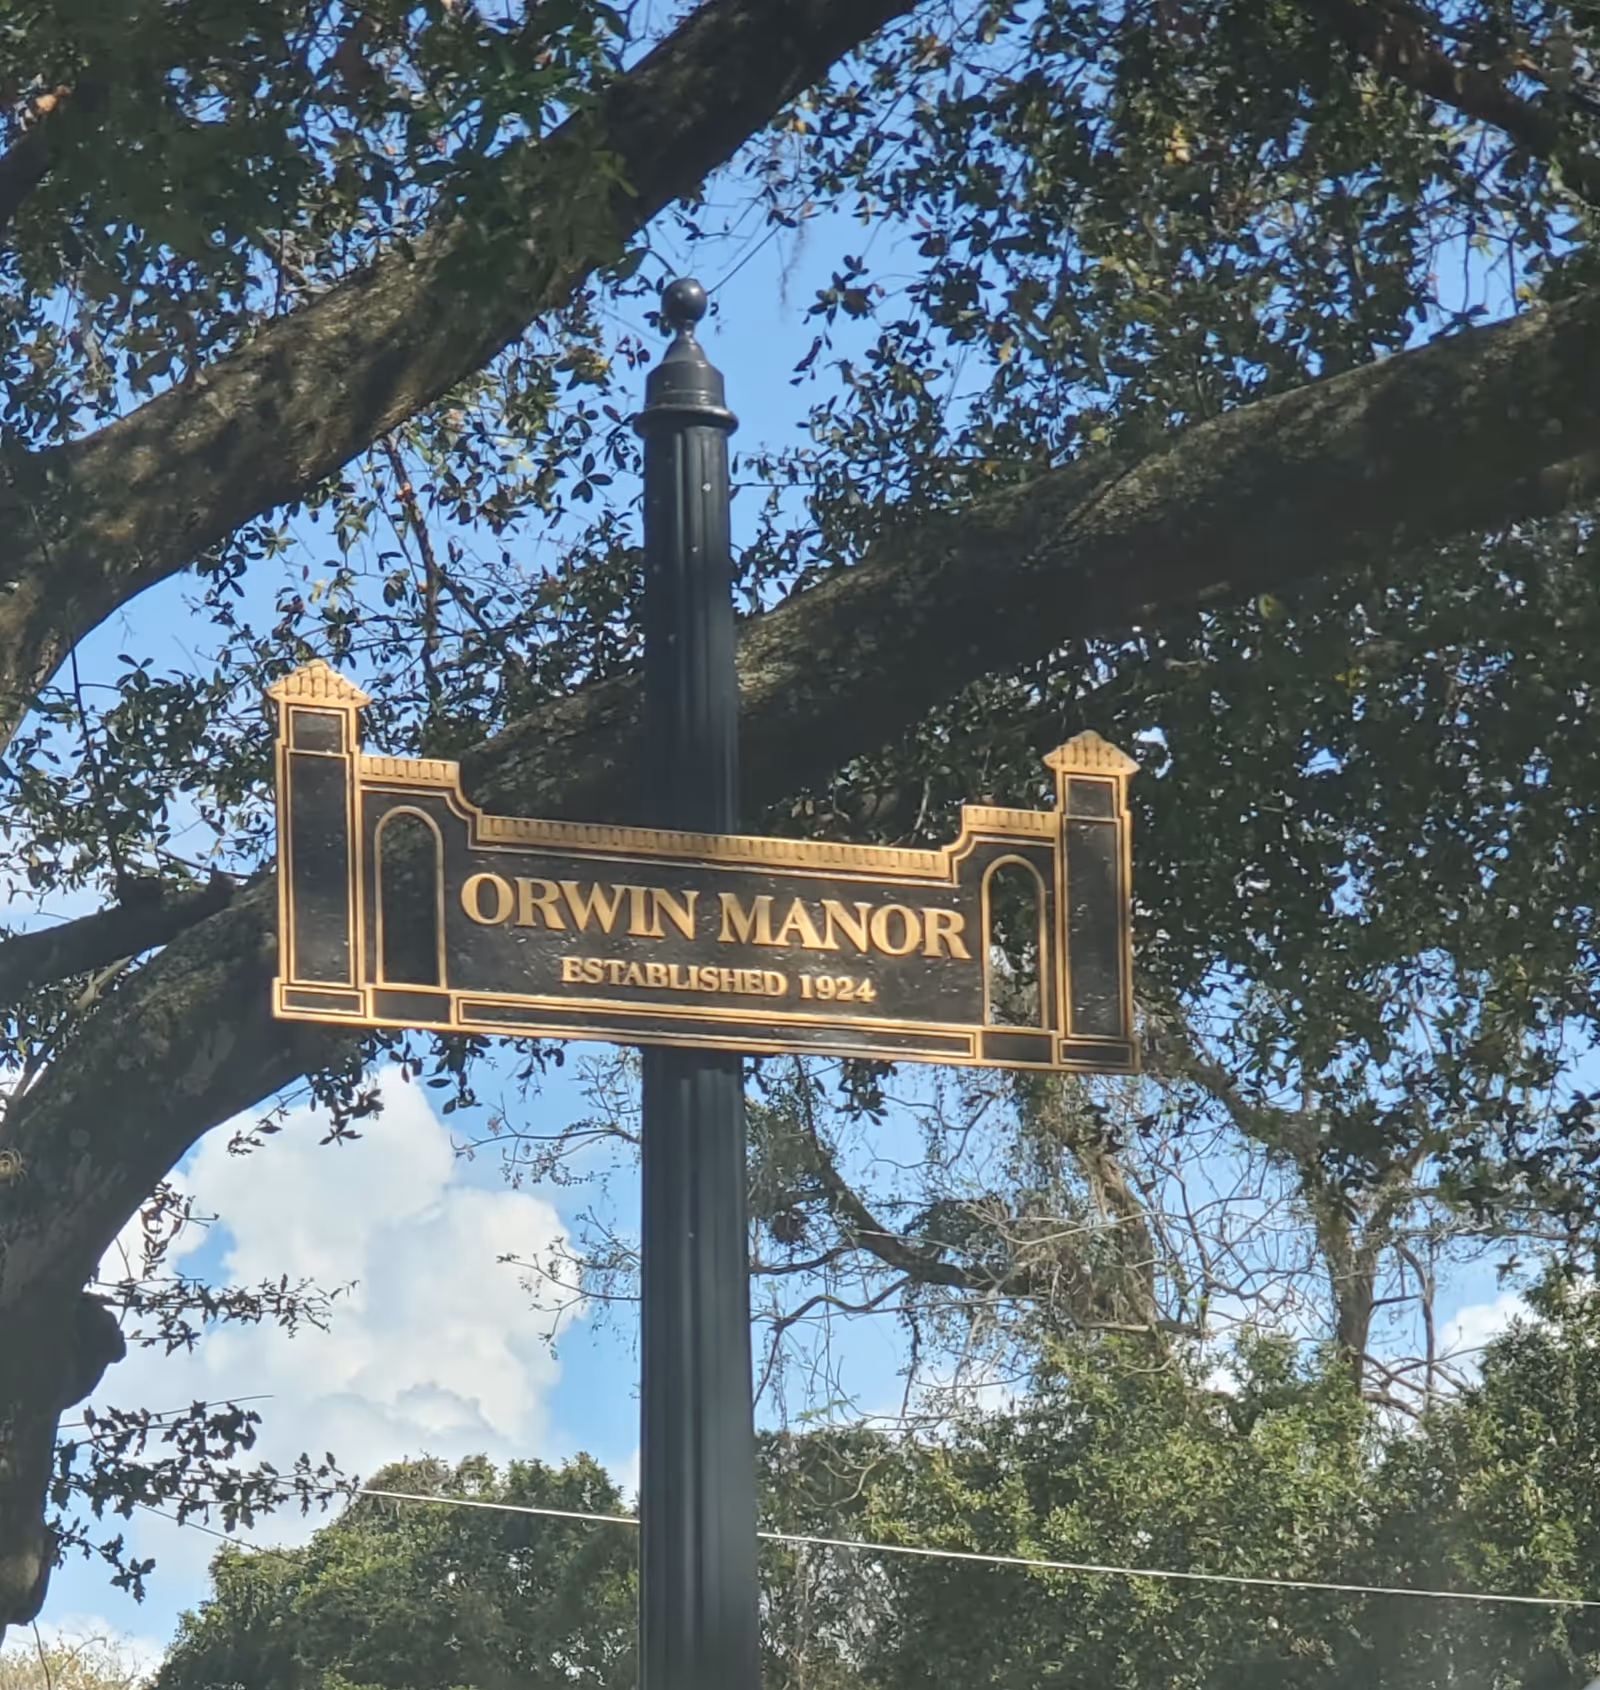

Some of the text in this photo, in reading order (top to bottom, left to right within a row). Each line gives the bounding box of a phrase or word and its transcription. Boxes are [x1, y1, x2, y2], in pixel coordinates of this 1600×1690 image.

[461, 873, 971, 959] ORWIN MANOR
[561, 957, 876, 1002] ESTABLISHED 1924
